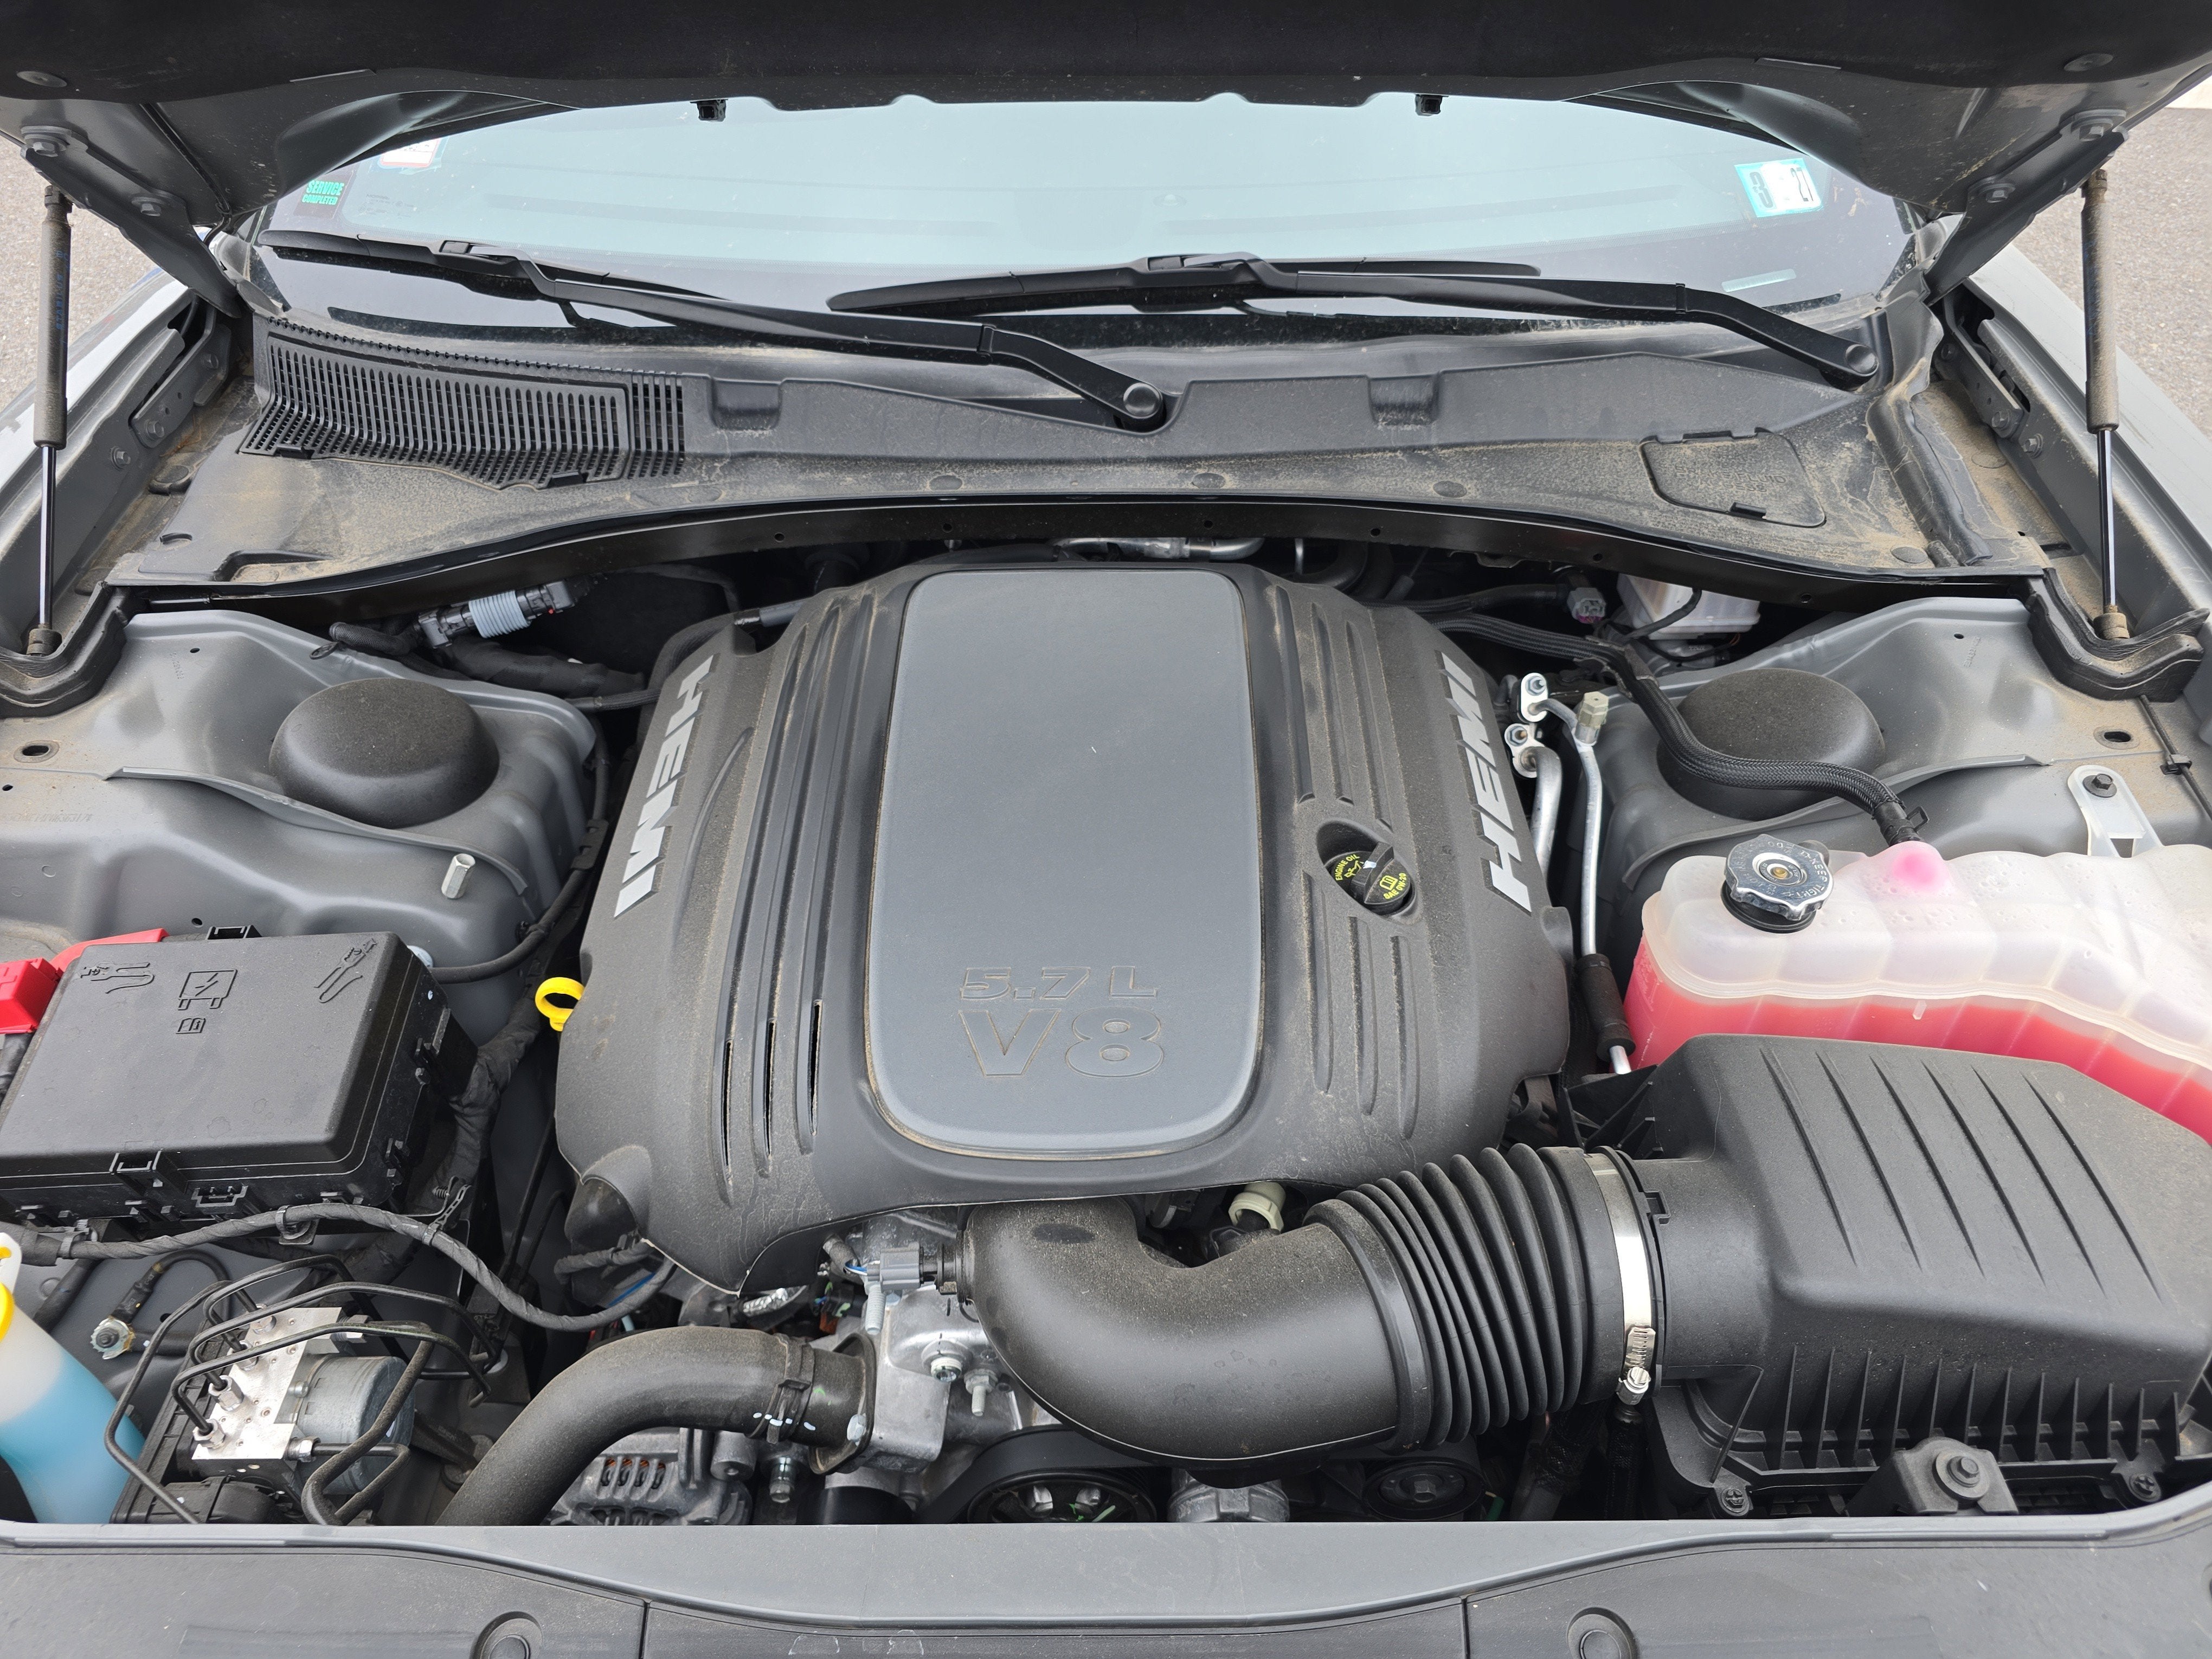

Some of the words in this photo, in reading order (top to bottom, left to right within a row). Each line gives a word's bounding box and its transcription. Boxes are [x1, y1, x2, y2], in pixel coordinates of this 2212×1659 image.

[302, 194, 338, 205] COMPLETED
[306, 180, 345, 196] SERVICE
[1735, 472, 1787, 484] FLUID
[614, 654, 713, 918] HEMI
[1440, 652, 1532, 914] HEMI
[1335, 859, 1348, 881] ENGINE
[1346, 854, 1360, 862] OIL
[1383, 889, 1399, 899] SAE
[1396, 872, 1407, 891] 0W-20
[1795, 884, 1825, 898] TIGHT
[958, 1006, 1166, 1078] V8
